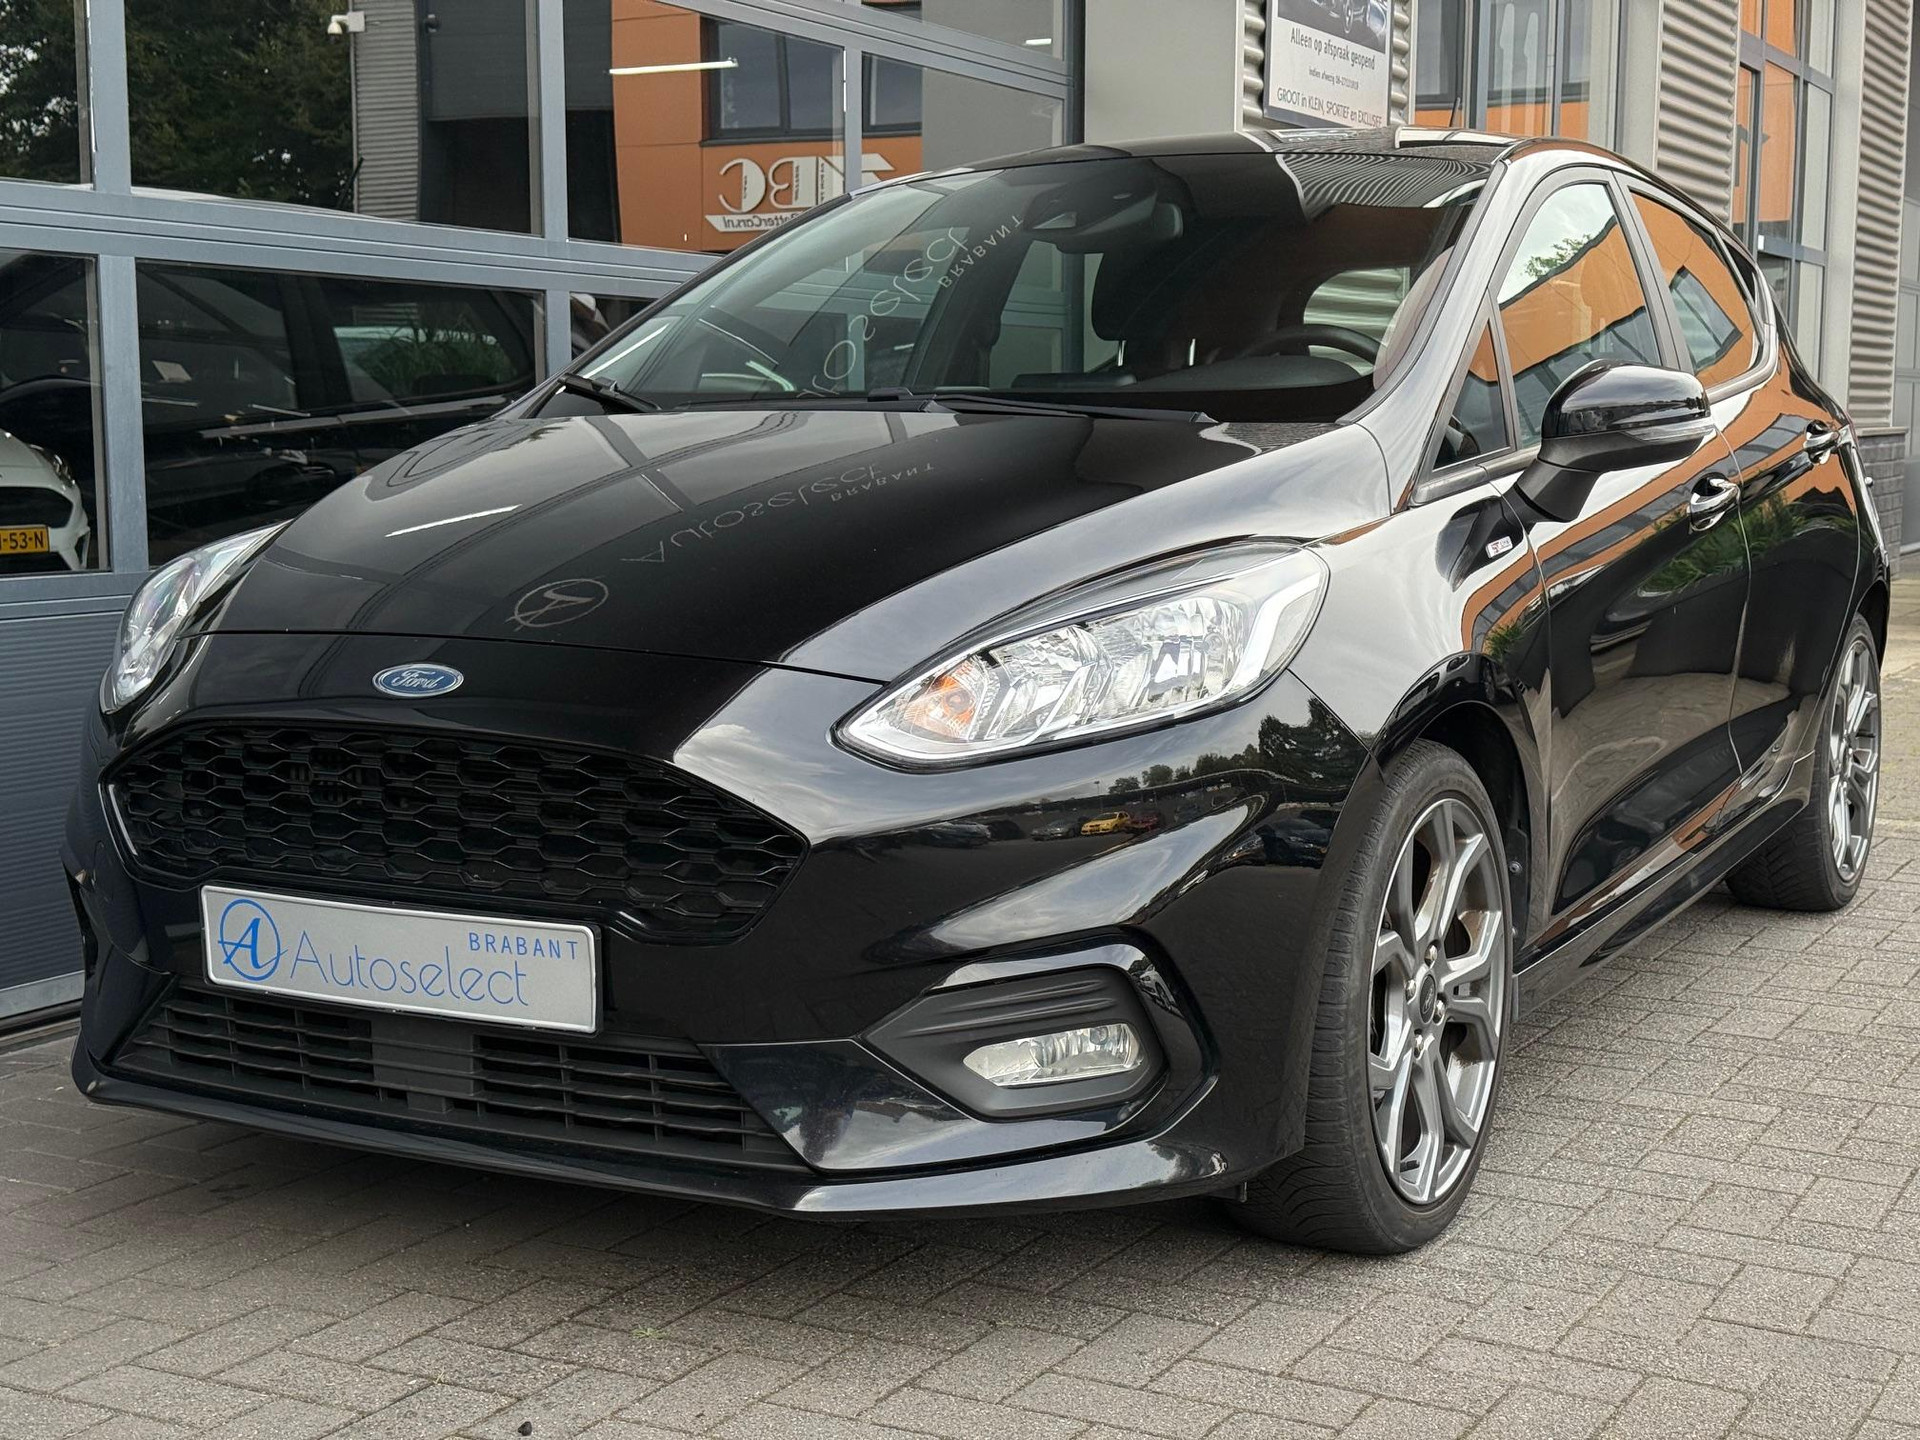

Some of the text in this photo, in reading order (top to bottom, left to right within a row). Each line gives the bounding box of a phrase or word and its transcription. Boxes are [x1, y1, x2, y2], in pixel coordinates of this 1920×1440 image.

[1290, 27, 1376, 70] Alleen op afspraak geopend
[1277, 87, 1300, 106] GROOT
[1300, 93, 1307, 108] in
[1326, 100, 1350, 120] SPORTIEF
[1350, 110, 1357, 122] en
[0, 532, 44, 551] -53-N
[391, 669, 444, 689] Ford
[469, 932, 579, 961] BRABANT
[290, 930, 529, 1007] Autoselect
